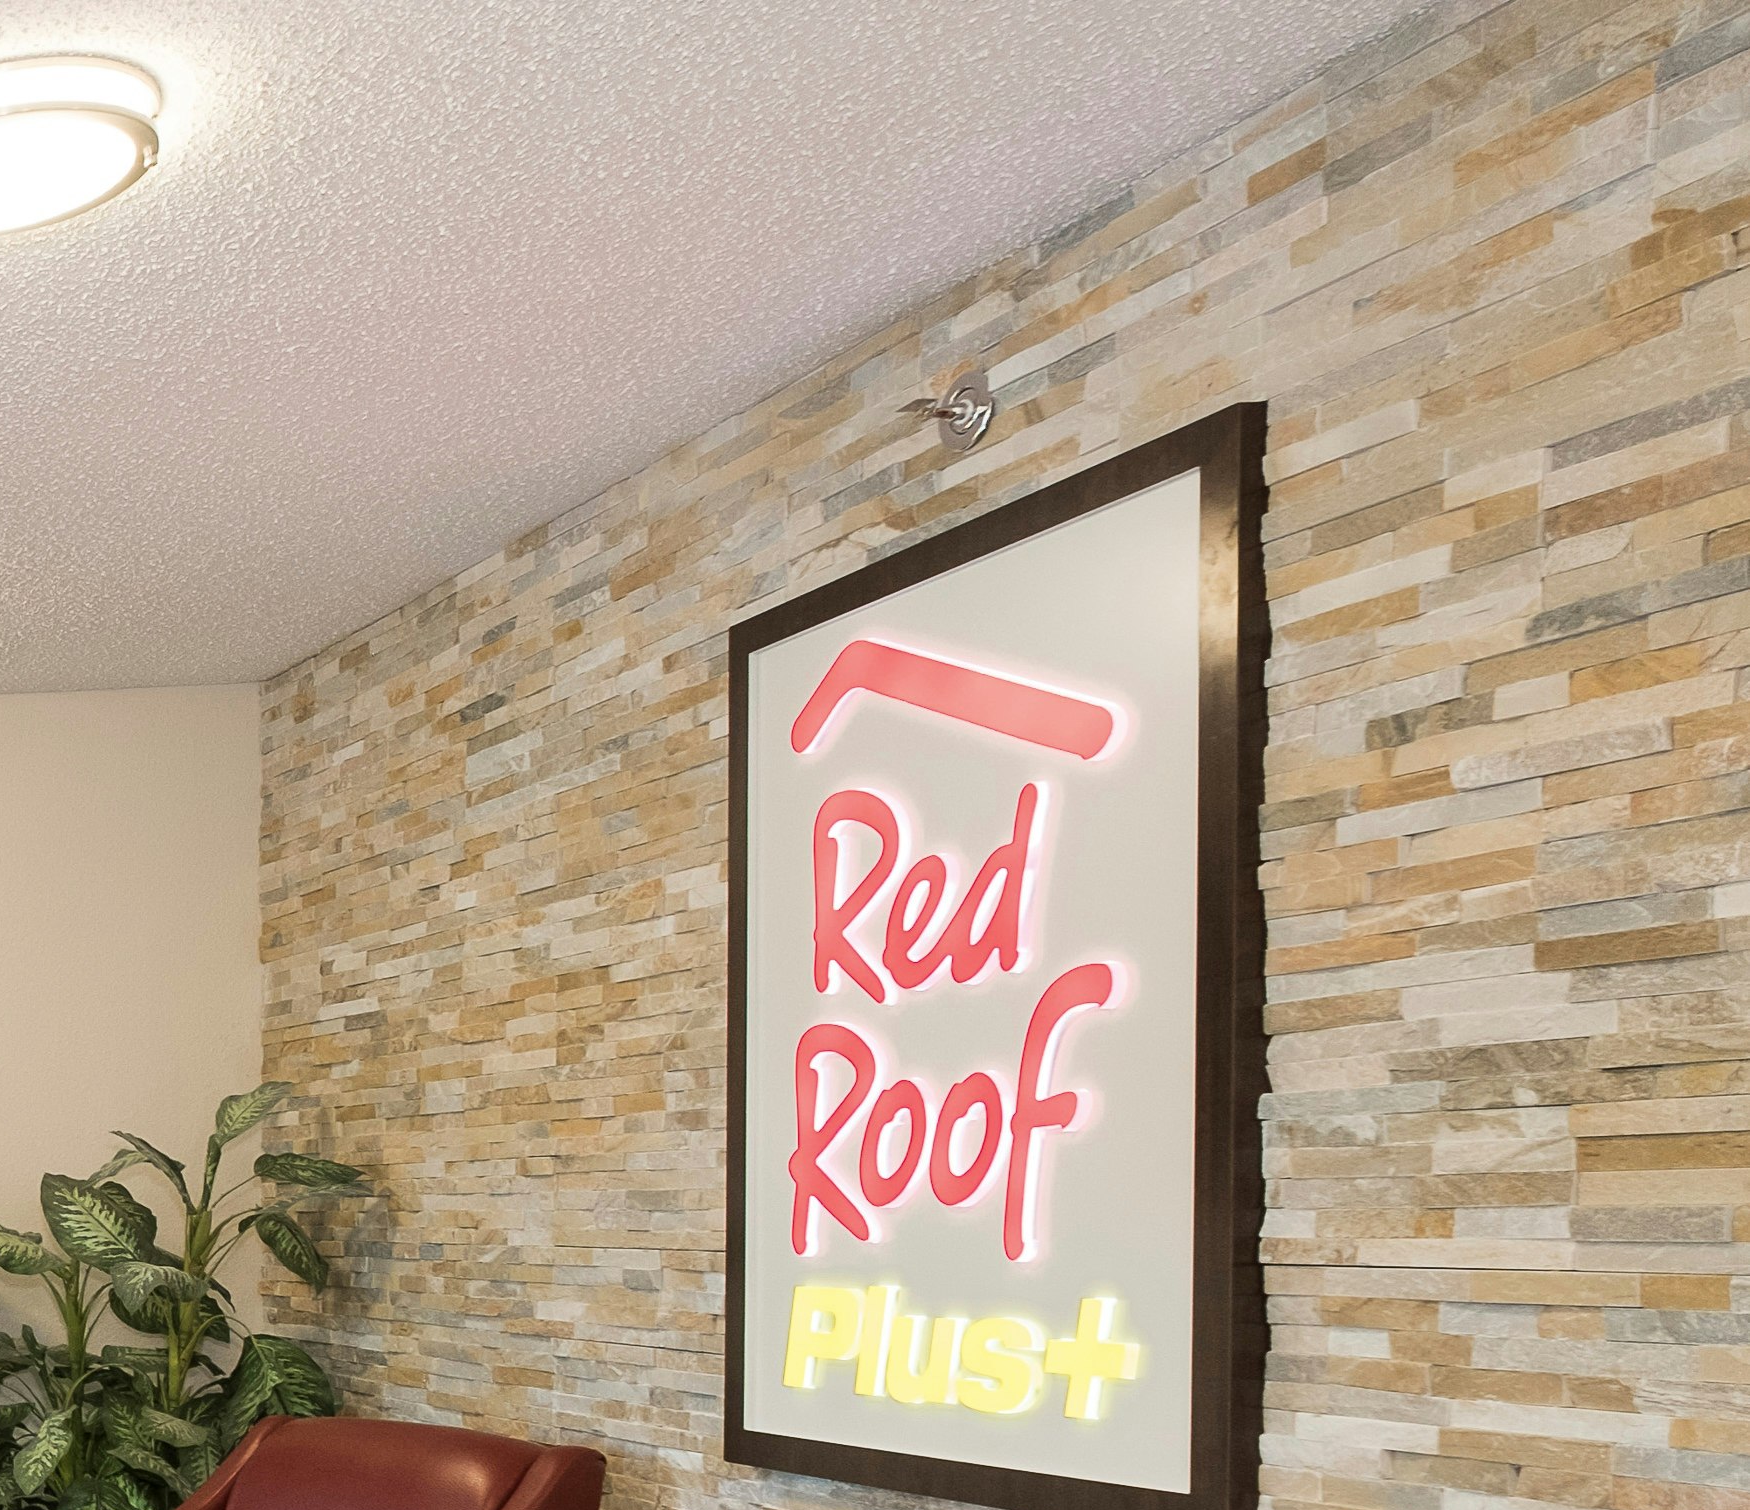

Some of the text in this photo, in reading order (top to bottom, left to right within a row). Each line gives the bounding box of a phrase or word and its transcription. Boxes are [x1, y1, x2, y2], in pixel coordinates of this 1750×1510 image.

[813, 783, 1048, 1003] Red
[788, 962, 1122, 1261] Roof
[783, 1284, 1139, 1420] Plus+
